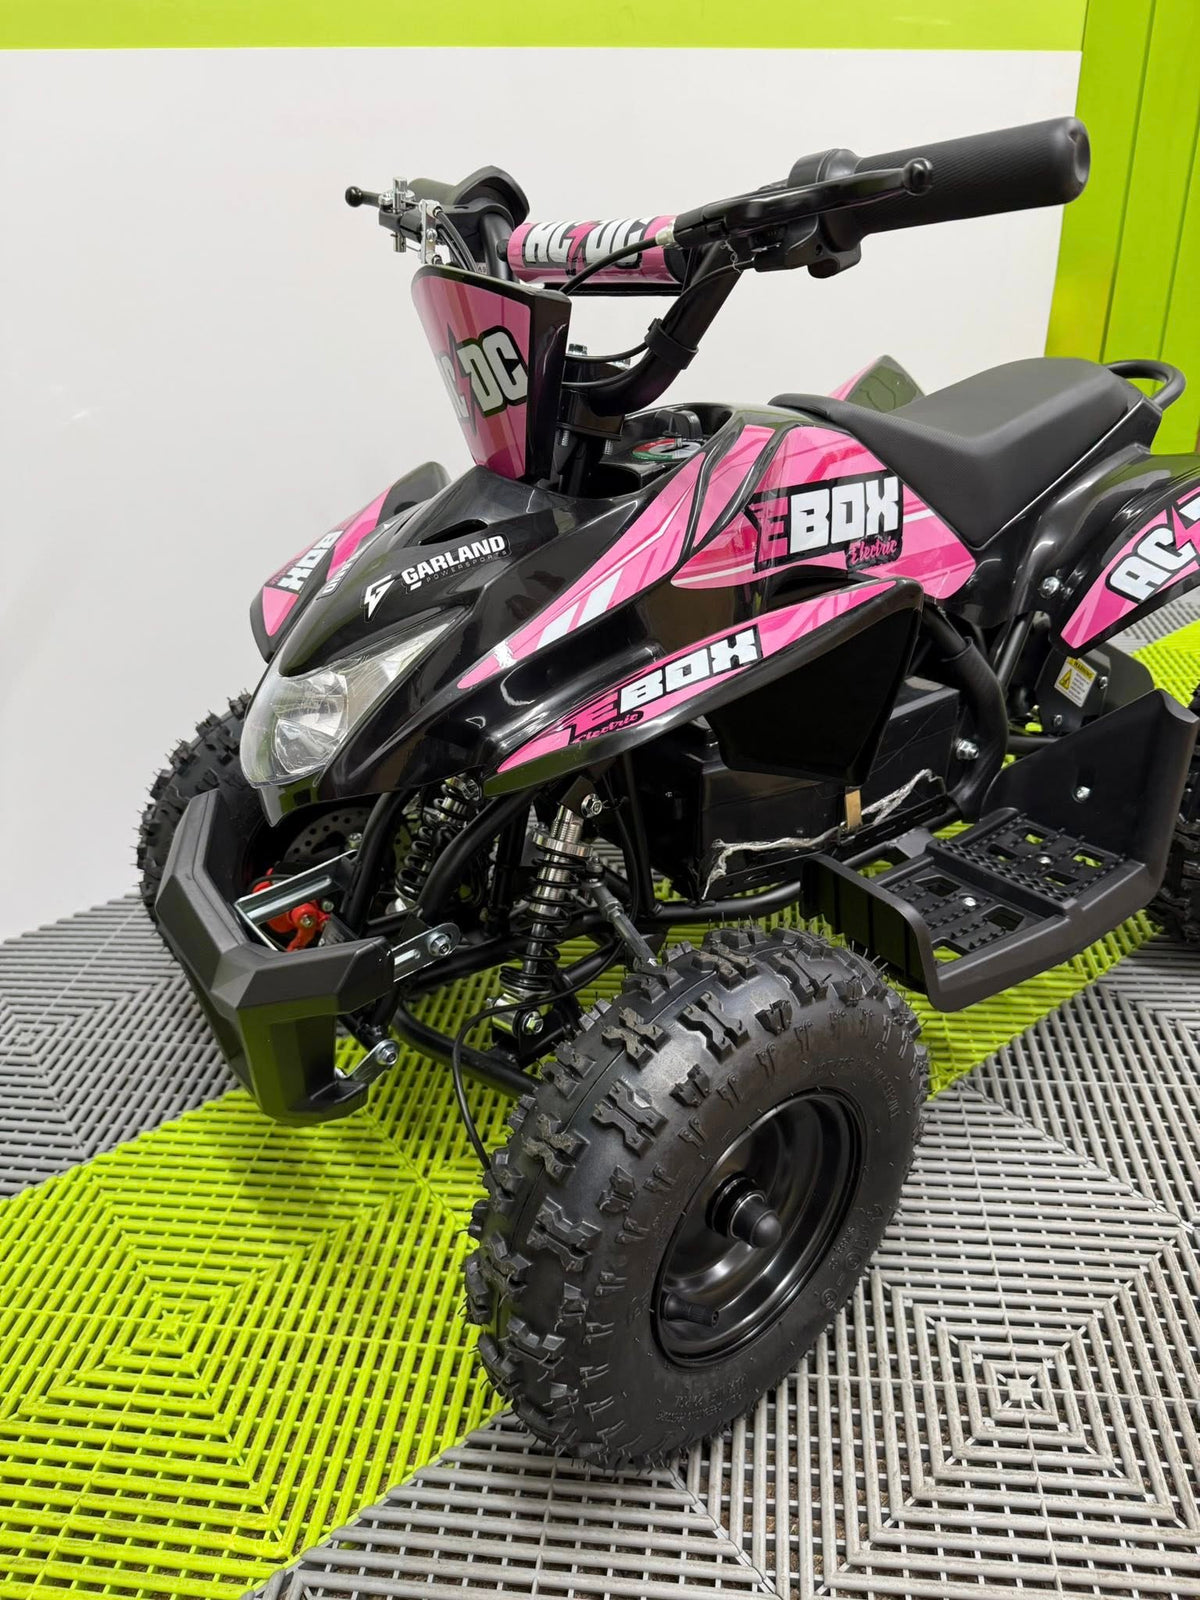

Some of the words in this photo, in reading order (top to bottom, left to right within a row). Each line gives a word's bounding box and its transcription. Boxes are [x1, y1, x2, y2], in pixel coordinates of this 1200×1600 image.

[277, 530, 344, 591] BOX
[401, 535, 506, 588] GARLAND
[426, 551, 508, 583] POWERSPORTS
[850, 535, 898, 565] Electric
